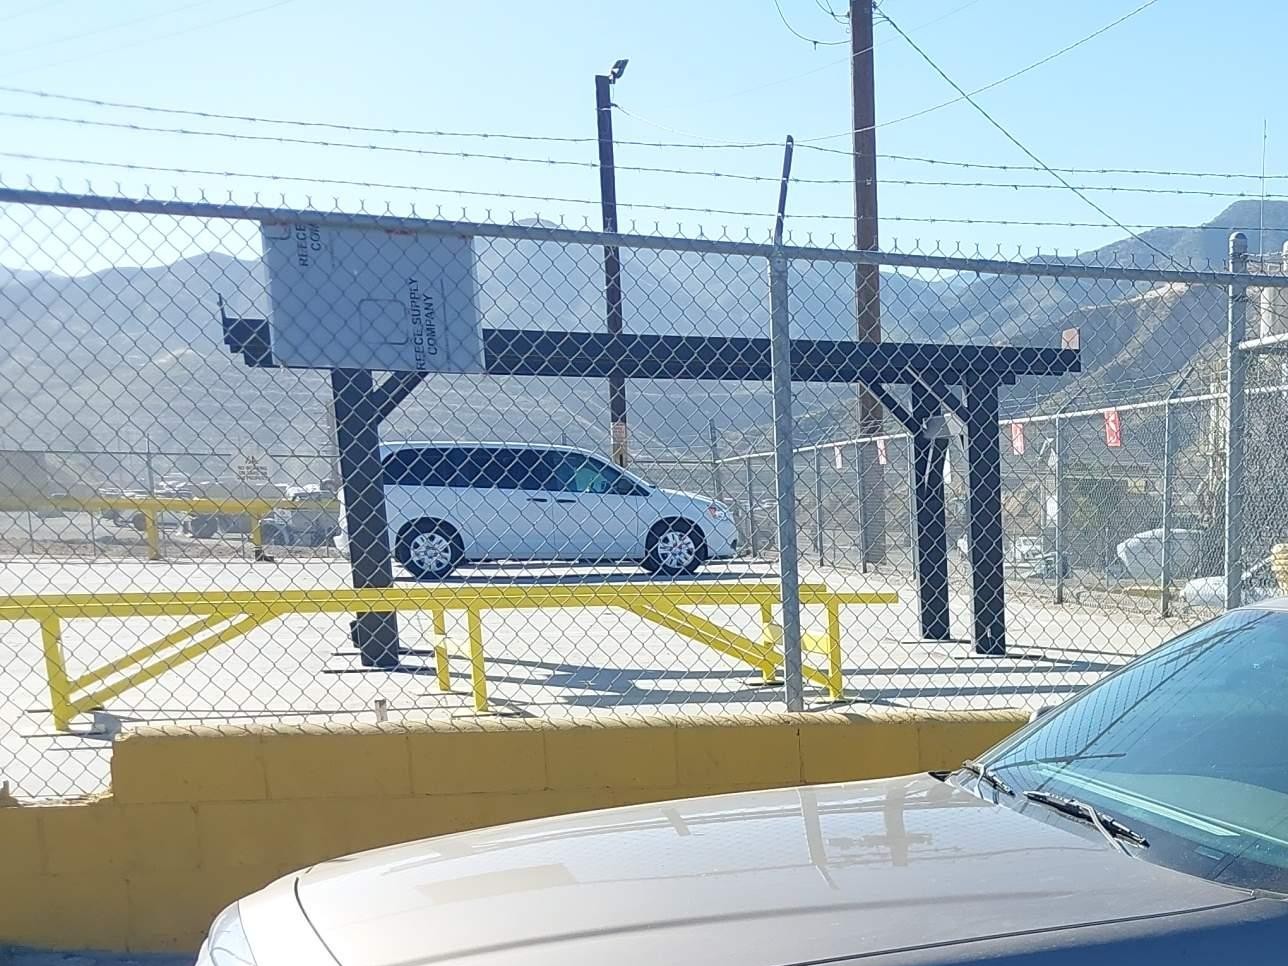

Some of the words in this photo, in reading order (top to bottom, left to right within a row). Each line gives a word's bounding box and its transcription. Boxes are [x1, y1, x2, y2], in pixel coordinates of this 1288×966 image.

[295, 223, 309, 267] REECE
[408, 277, 422, 325] SUPPLY
[423, 292, 438, 356] COMPANY
[413, 327, 427, 371] REECE
